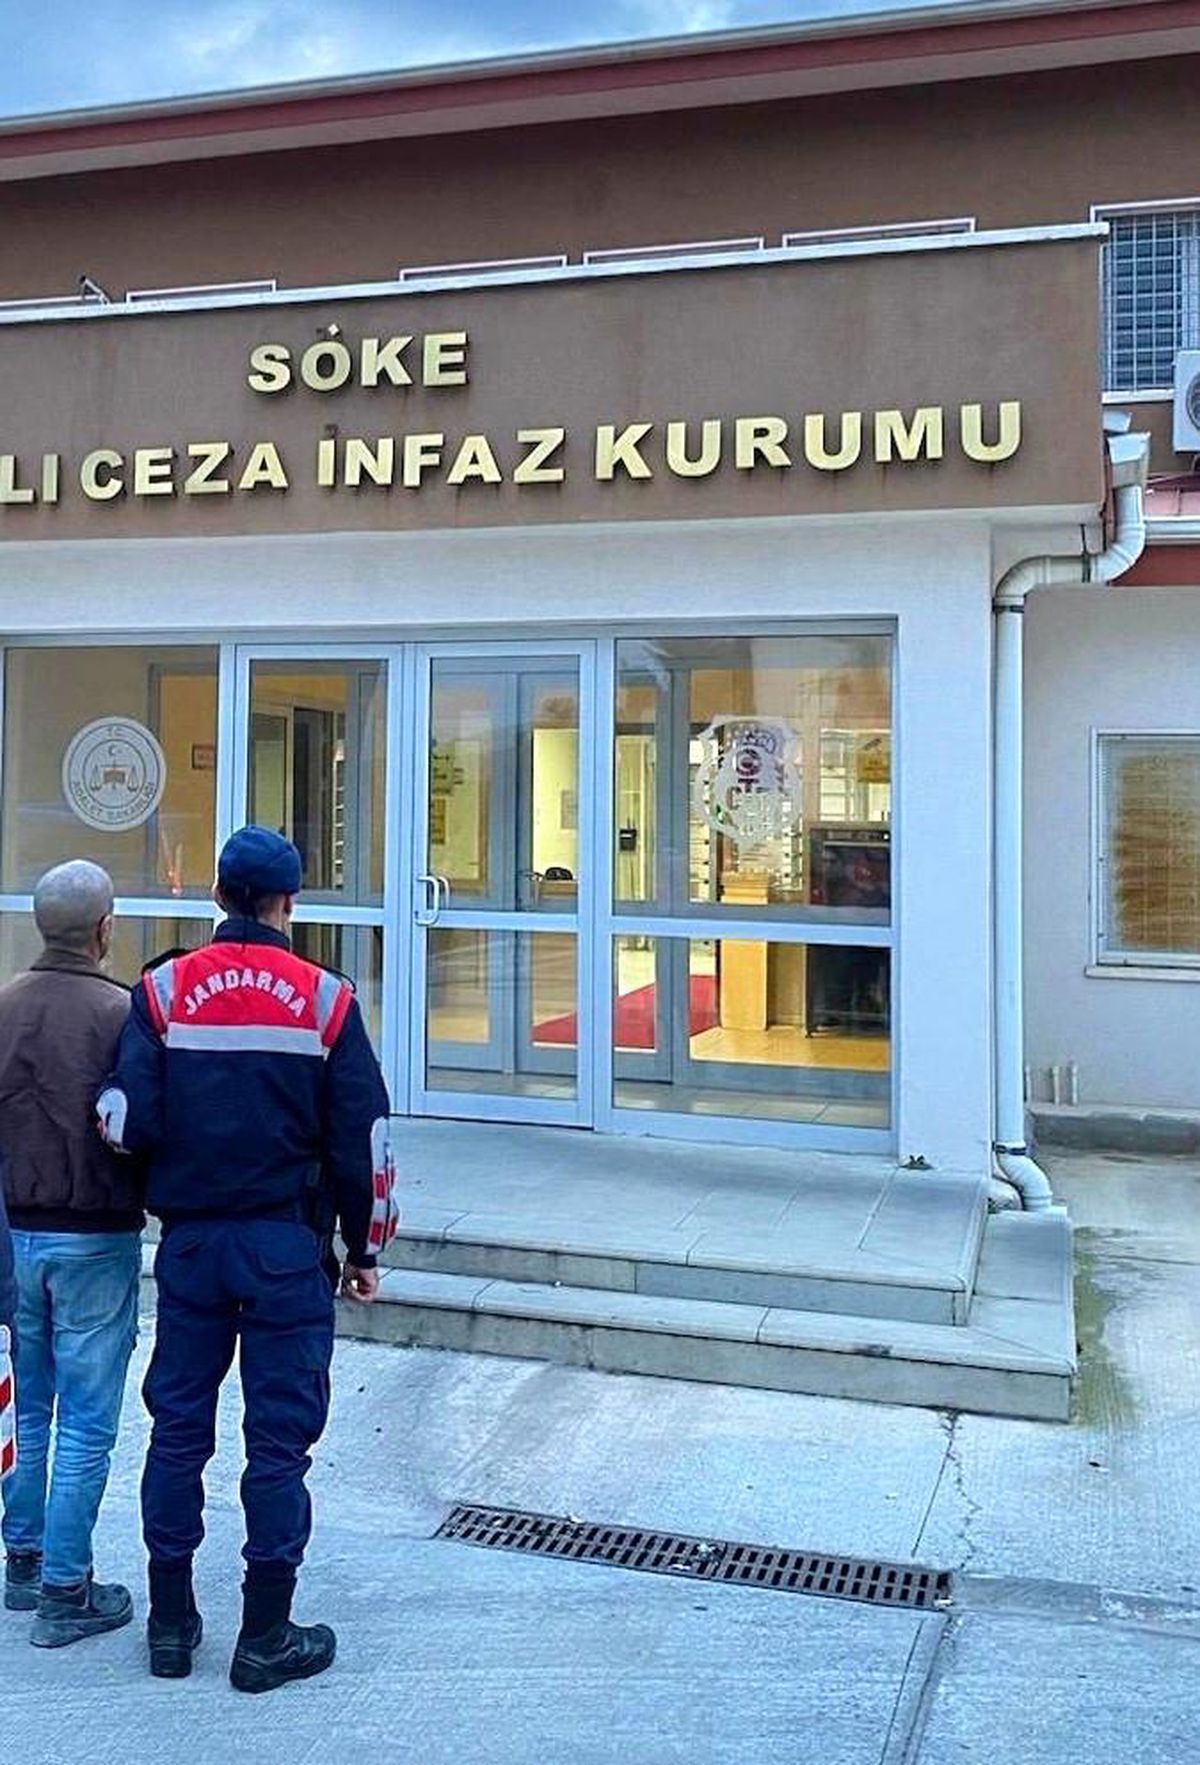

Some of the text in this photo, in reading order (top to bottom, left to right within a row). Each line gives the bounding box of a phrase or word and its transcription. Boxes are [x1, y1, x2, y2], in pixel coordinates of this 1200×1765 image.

[80, 442, 289, 501] CEZA
[595, 401, 1022, 480] KURUMU
[184, 968, 307, 1018] JANDARMA
